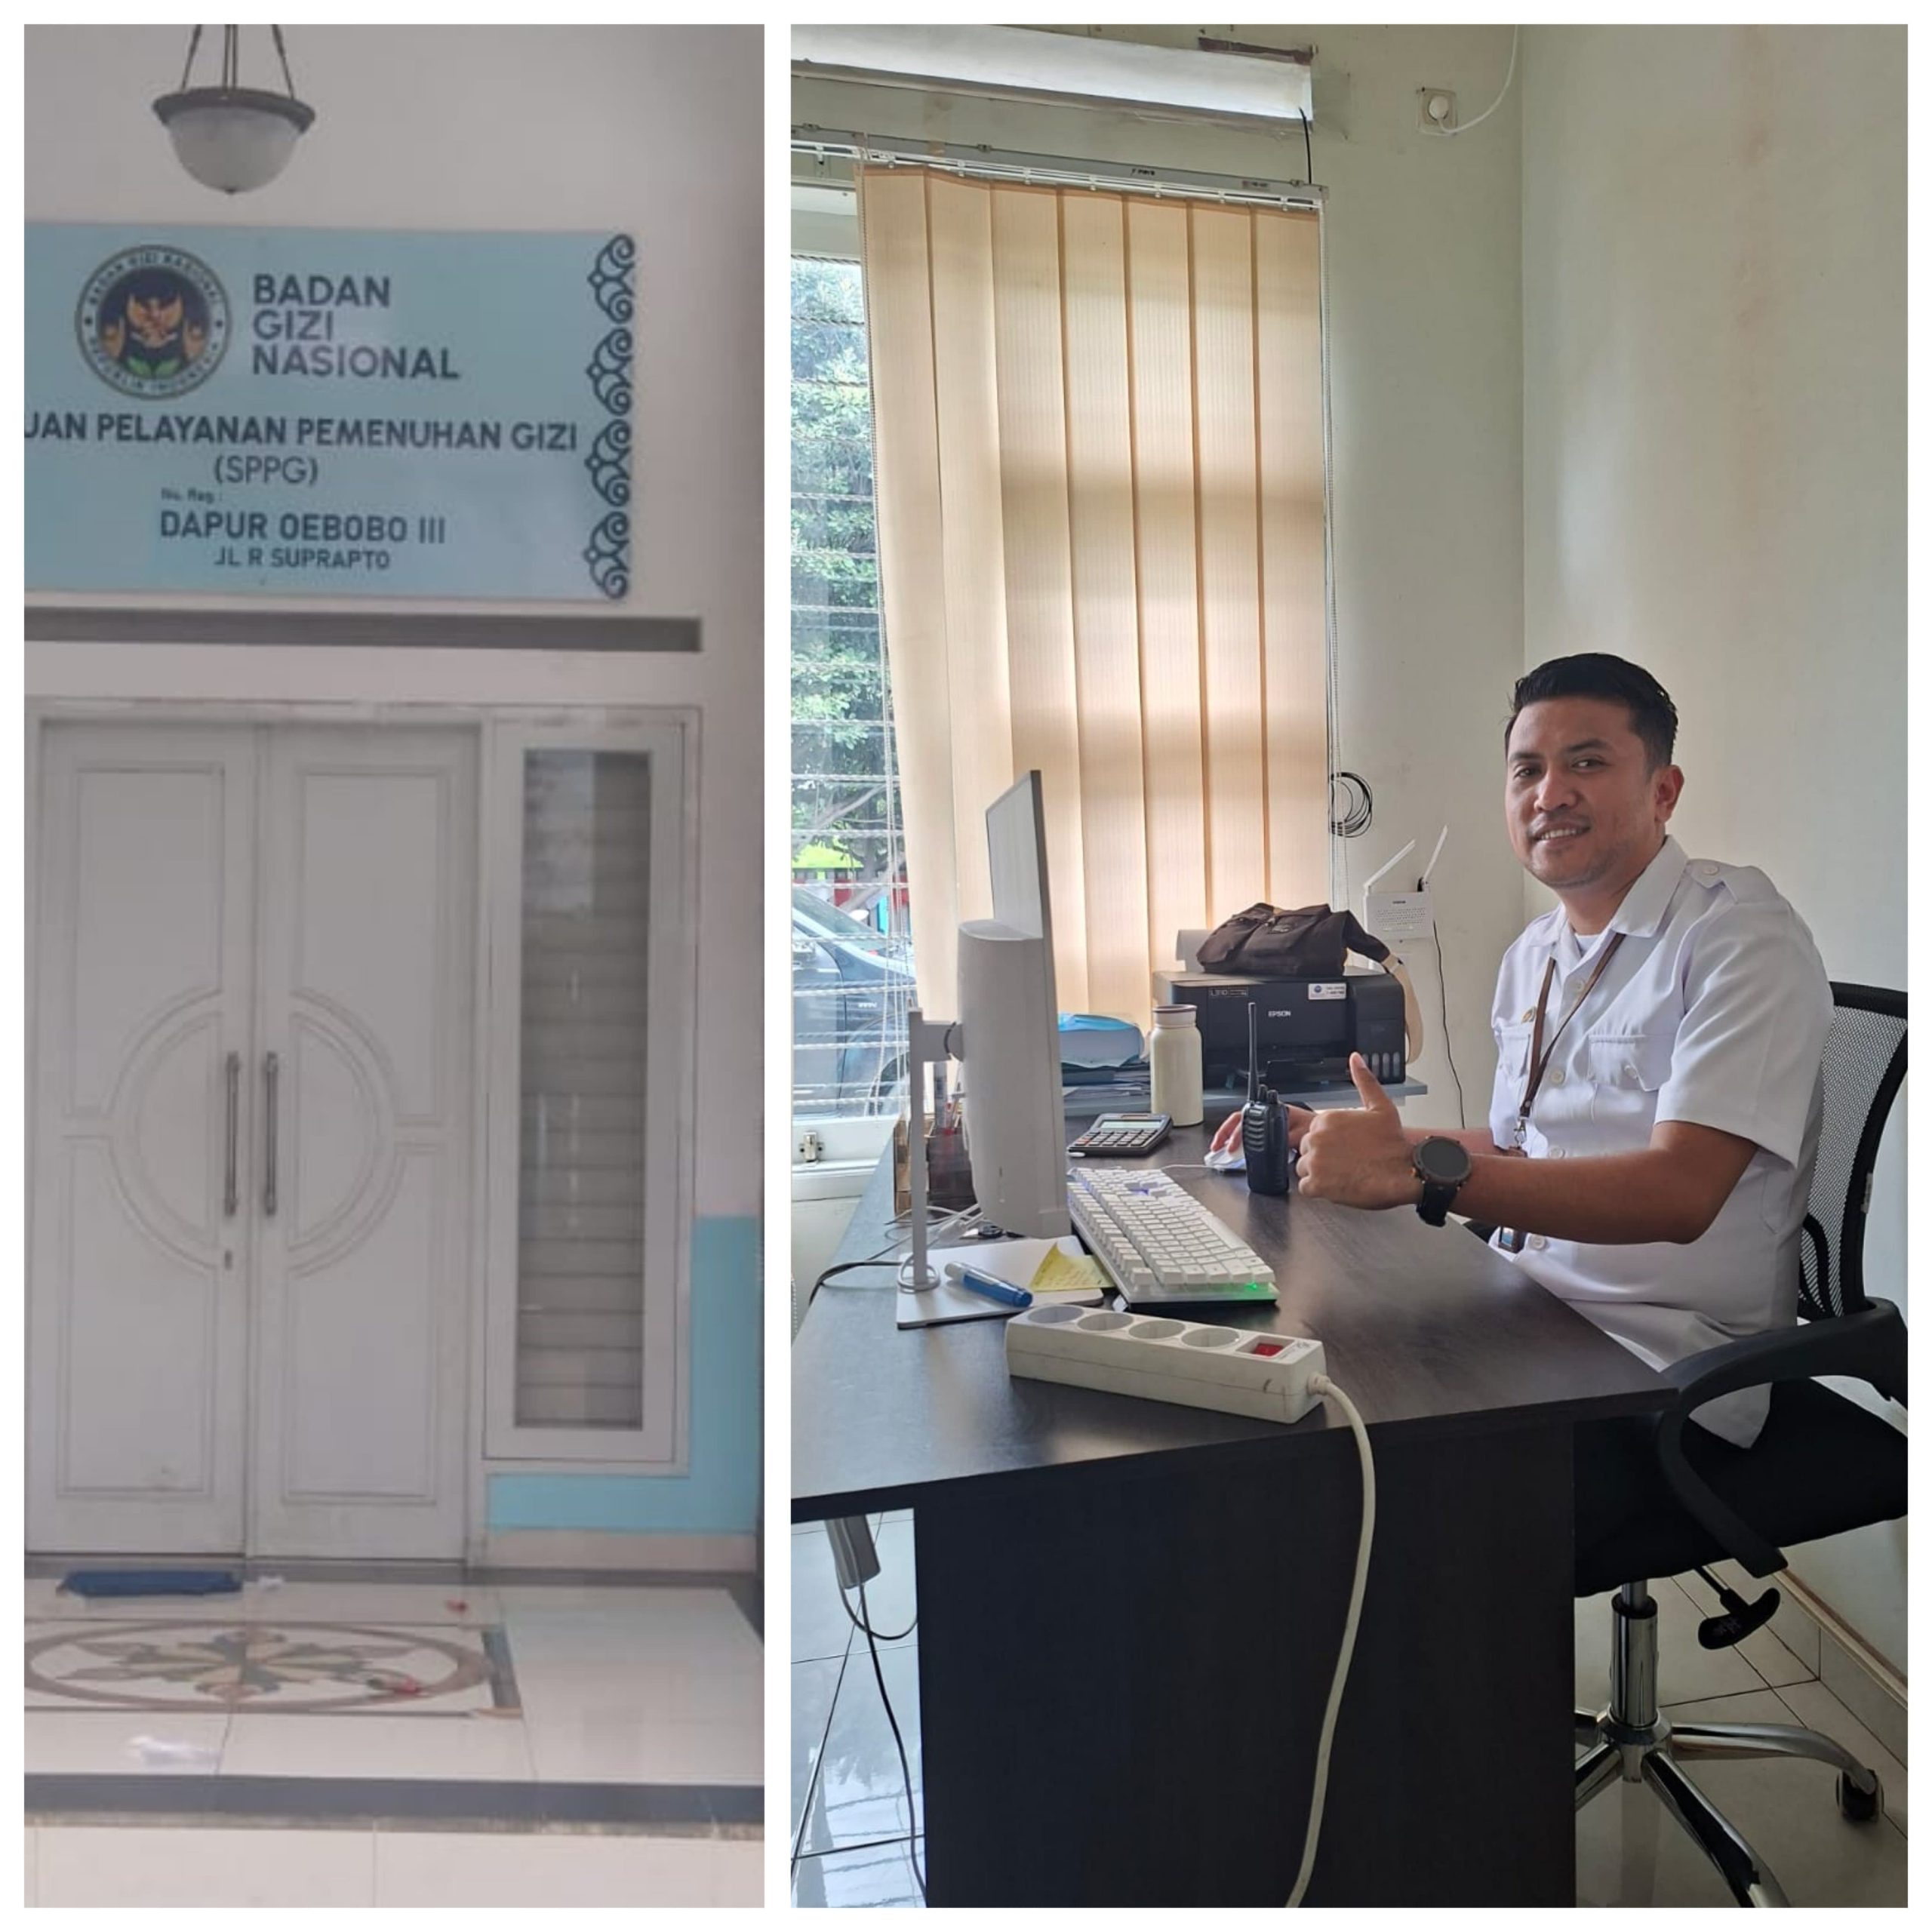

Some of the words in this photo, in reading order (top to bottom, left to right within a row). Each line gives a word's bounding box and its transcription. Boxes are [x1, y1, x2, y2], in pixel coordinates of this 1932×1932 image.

[254, 274, 390, 307] BADAN
[253, 309, 334, 340] GIZI
[253, 344, 460, 379] NASIONAL
[97, 414, 286, 445] PELAYANAN
[297, 418, 501, 451] PEMENUHAN
[511, 423, 577, 451] GIZI
[214, 454, 318, 488] (SPPG)
[161, 510, 267, 539] DAPUR
[280, 512, 408, 542] OEBOBO
[420, 516, 446, 544] III
[214, 546, 241, 566] JL
[248, 547, 263, 568] R
[271, 548, 390, 571] SUPRAPTO
